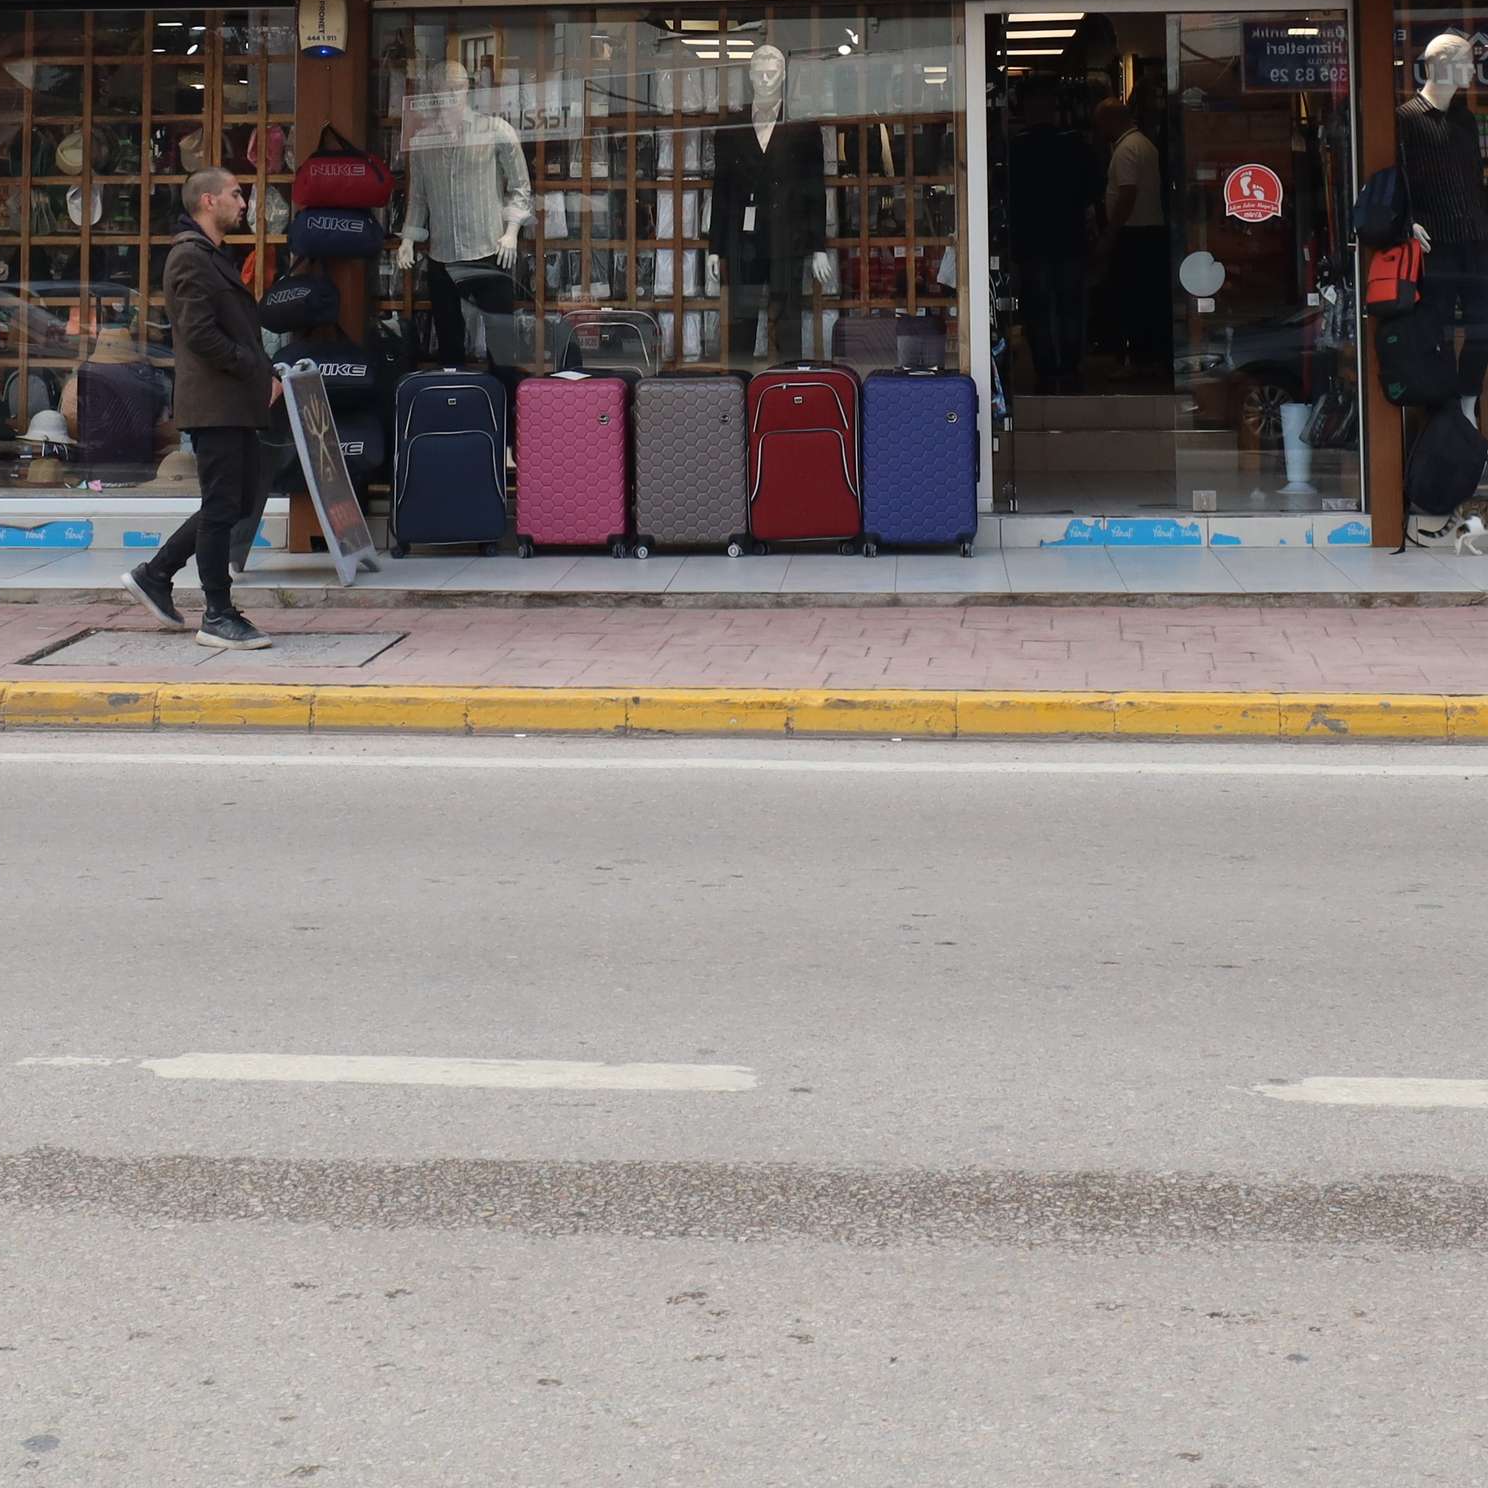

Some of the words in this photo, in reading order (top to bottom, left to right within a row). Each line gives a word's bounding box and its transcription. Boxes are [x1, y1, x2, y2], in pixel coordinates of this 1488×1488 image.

[318, 0, 326, 34] PRONET
[310, 164, 366, 176] NIKE
[306, 216, 365, 233] NIKE
[266, 287, 312, 306] NIKE
